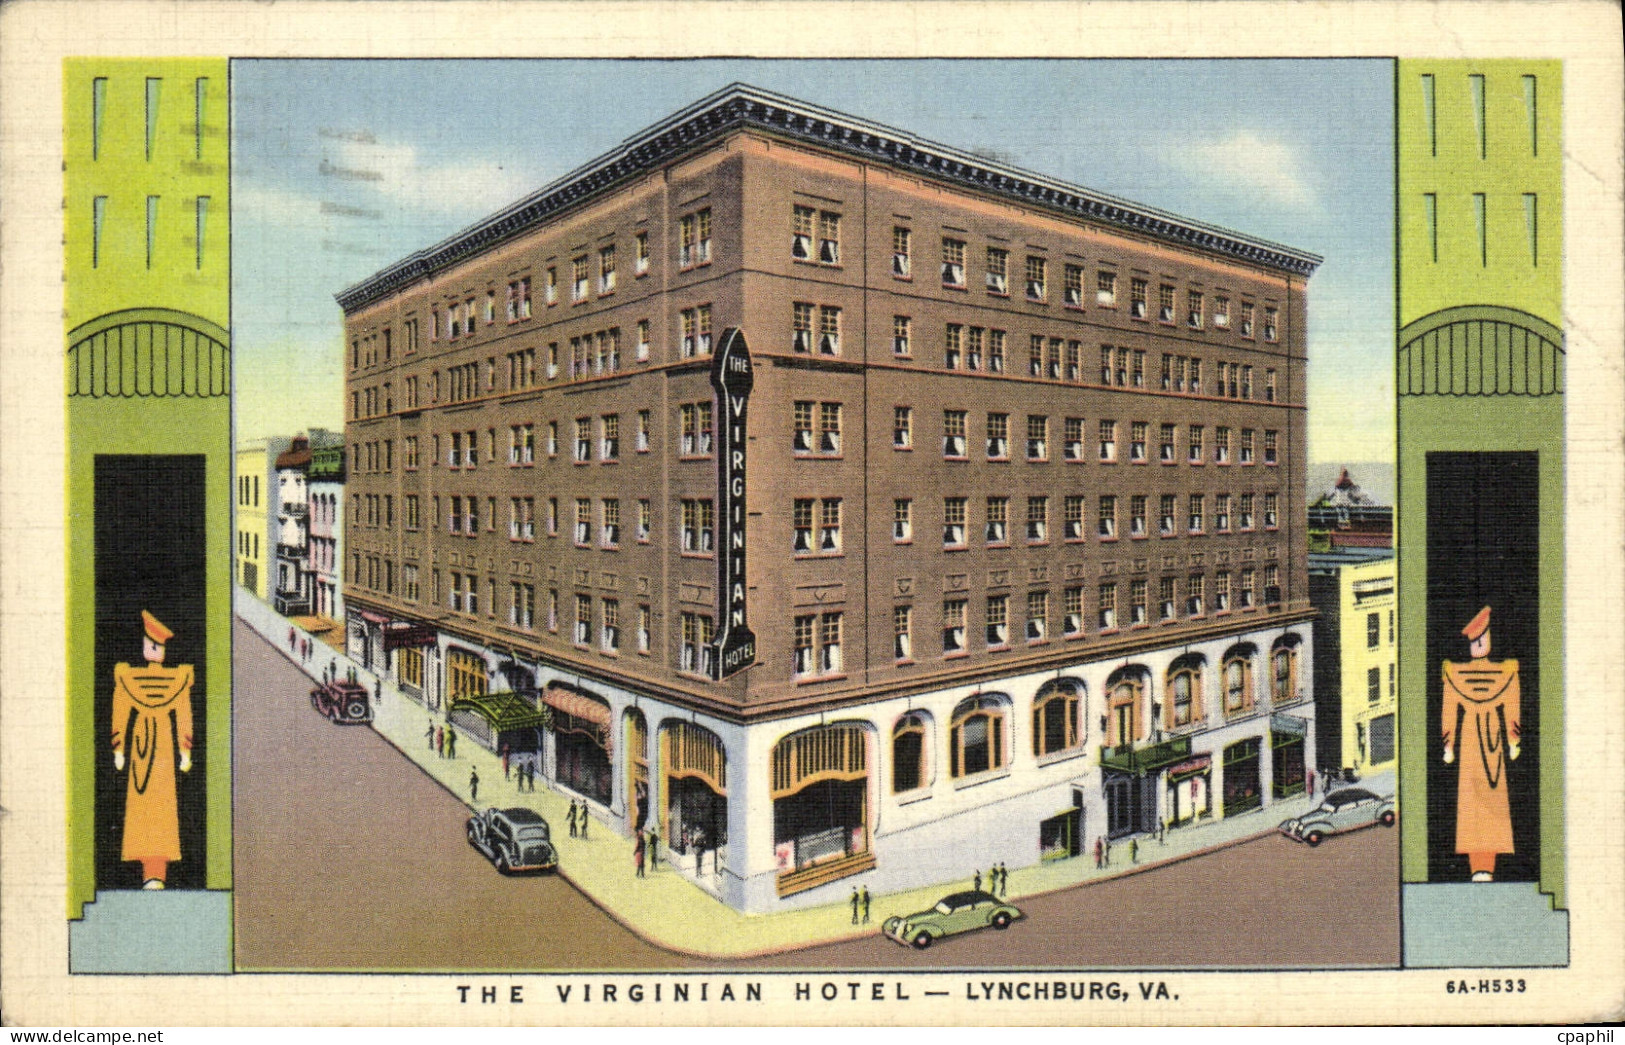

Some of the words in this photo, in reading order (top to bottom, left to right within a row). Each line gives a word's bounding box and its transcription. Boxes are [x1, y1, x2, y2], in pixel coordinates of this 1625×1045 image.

[729, 355, 748, 373] THE
[731, 395, 744, 628] VIRGINIAN
[725, 643, 755, 668] HOTEL
[456, 985, 524, 1004] THE
[556, 983, 762, 1003] VIRGINIAN
[795, 982, 910, 1001] HOTEL
[966, 981, 1129, 1002] LYNCHBURG,
[1139, 982, 1180, 1000] VA.
[1446, 979, 1527, 994] 6A-H533
